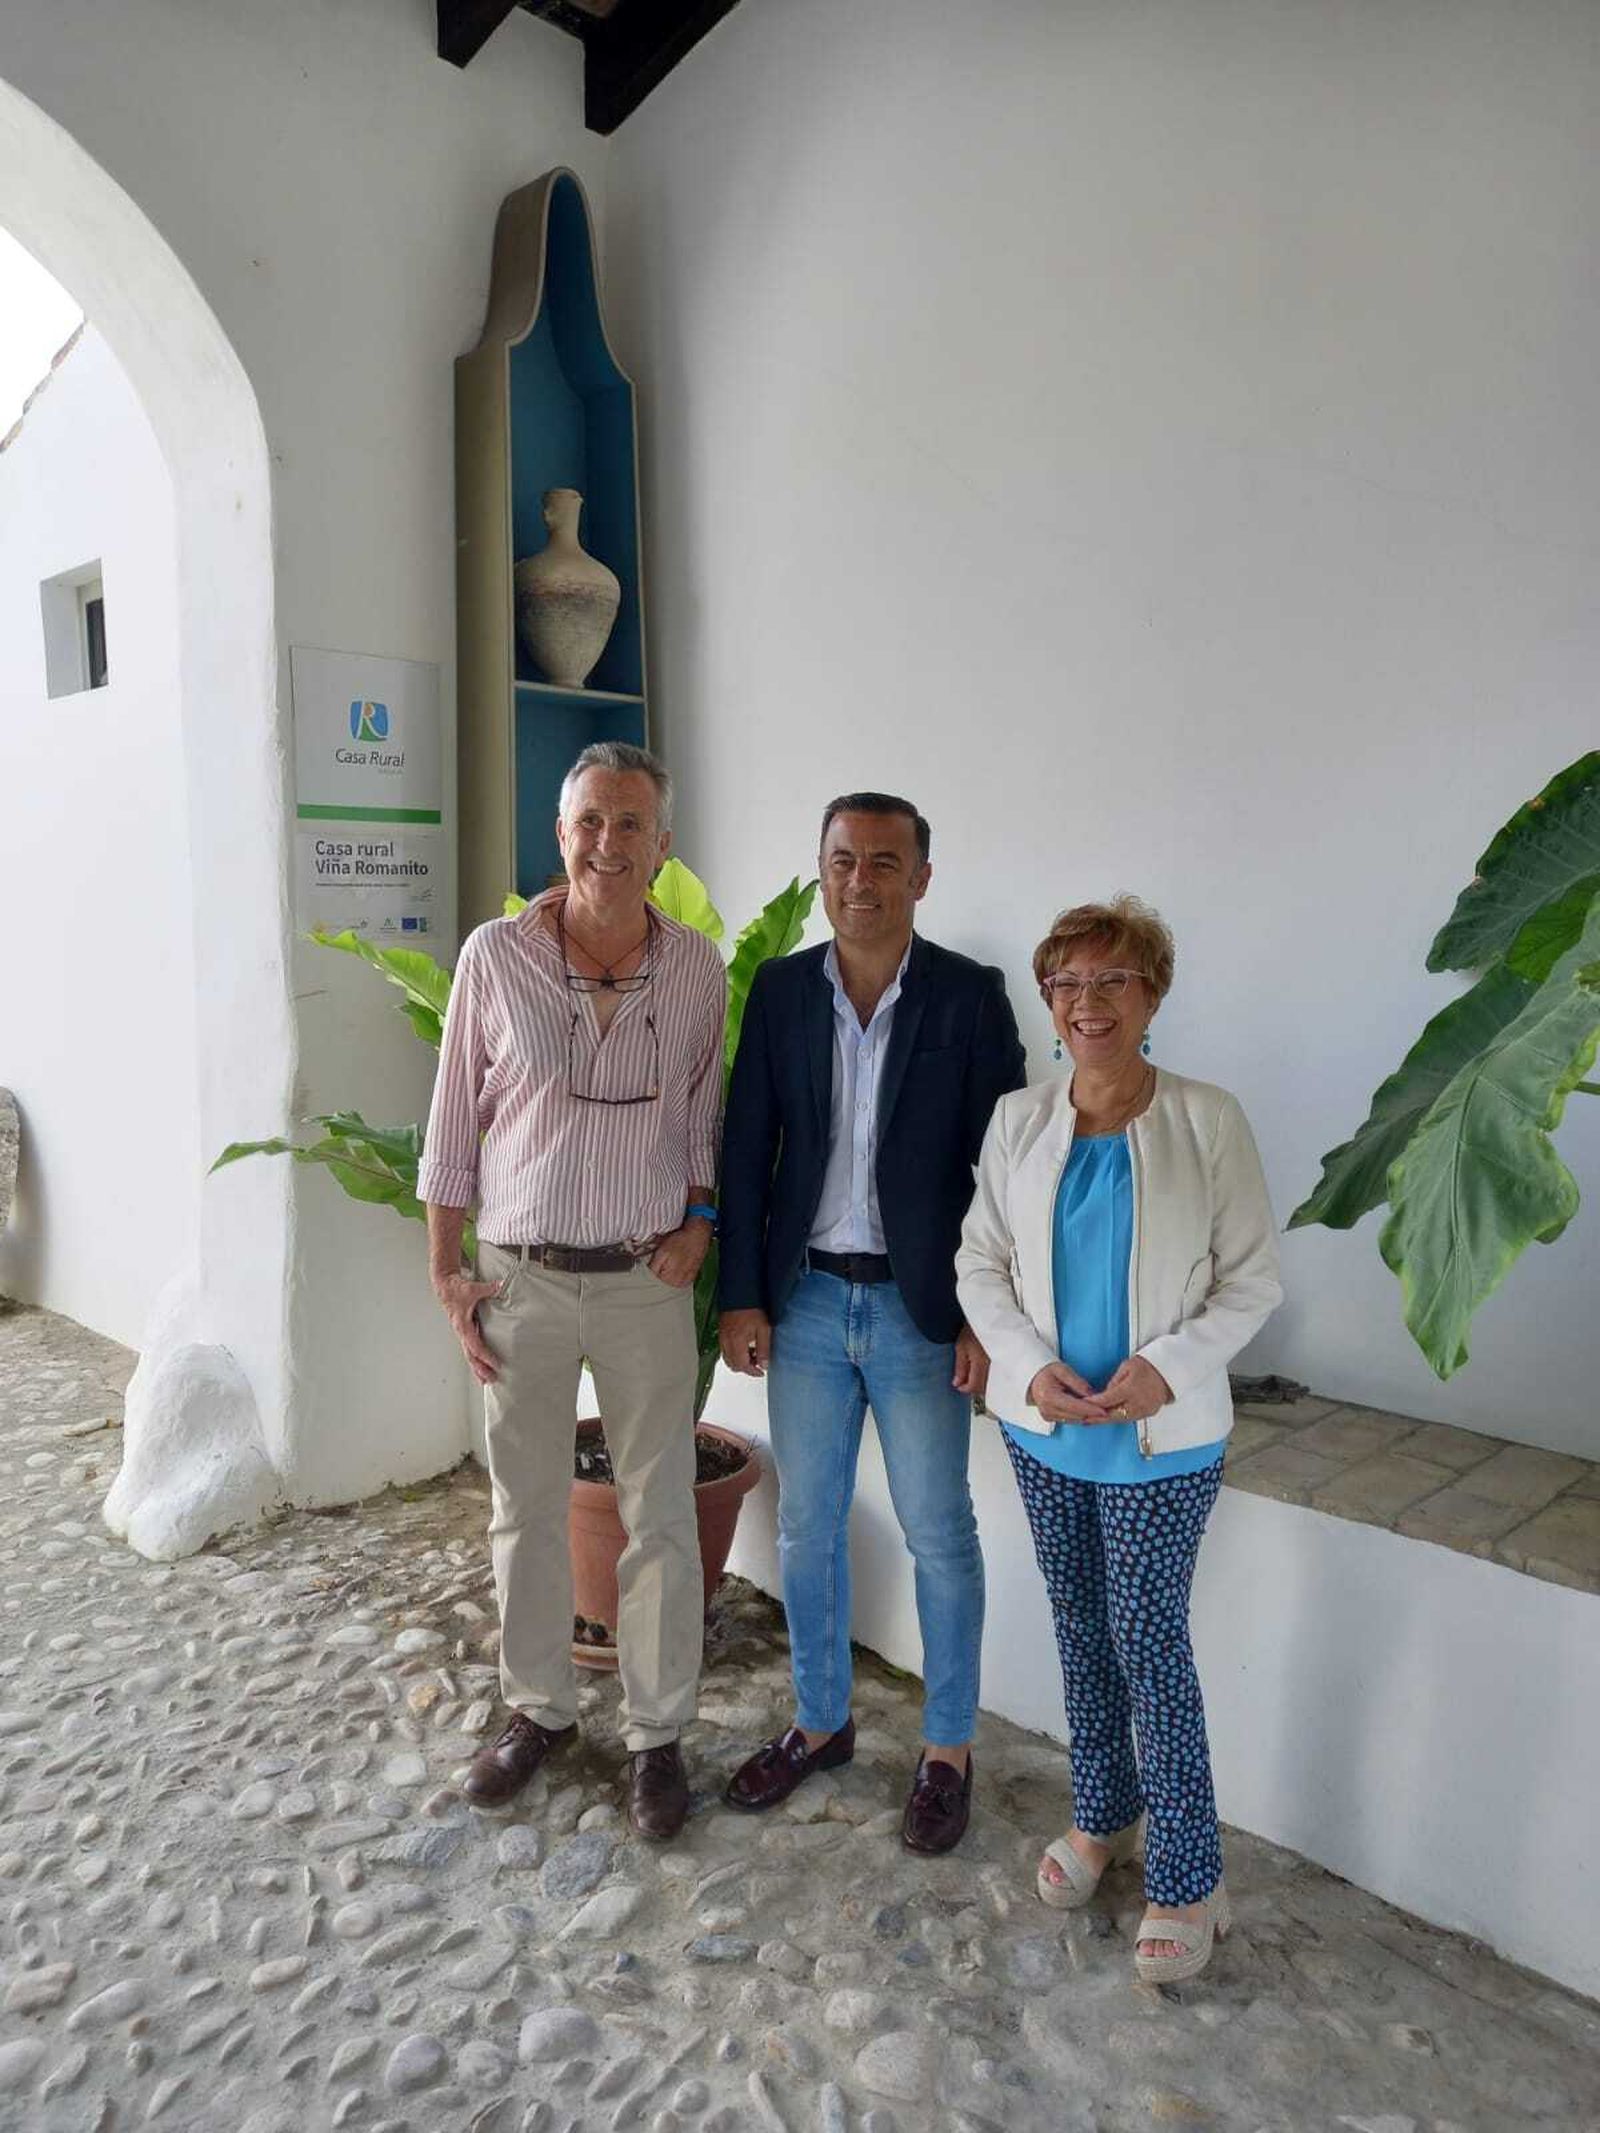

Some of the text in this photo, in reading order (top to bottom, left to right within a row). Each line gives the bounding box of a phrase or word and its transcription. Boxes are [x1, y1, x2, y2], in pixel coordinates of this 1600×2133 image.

[335, 747, 405, 767] Casa Rural
[315, 840, 394, 857] Casa rural
[315, 858, 429, 876] Viña Romanito
